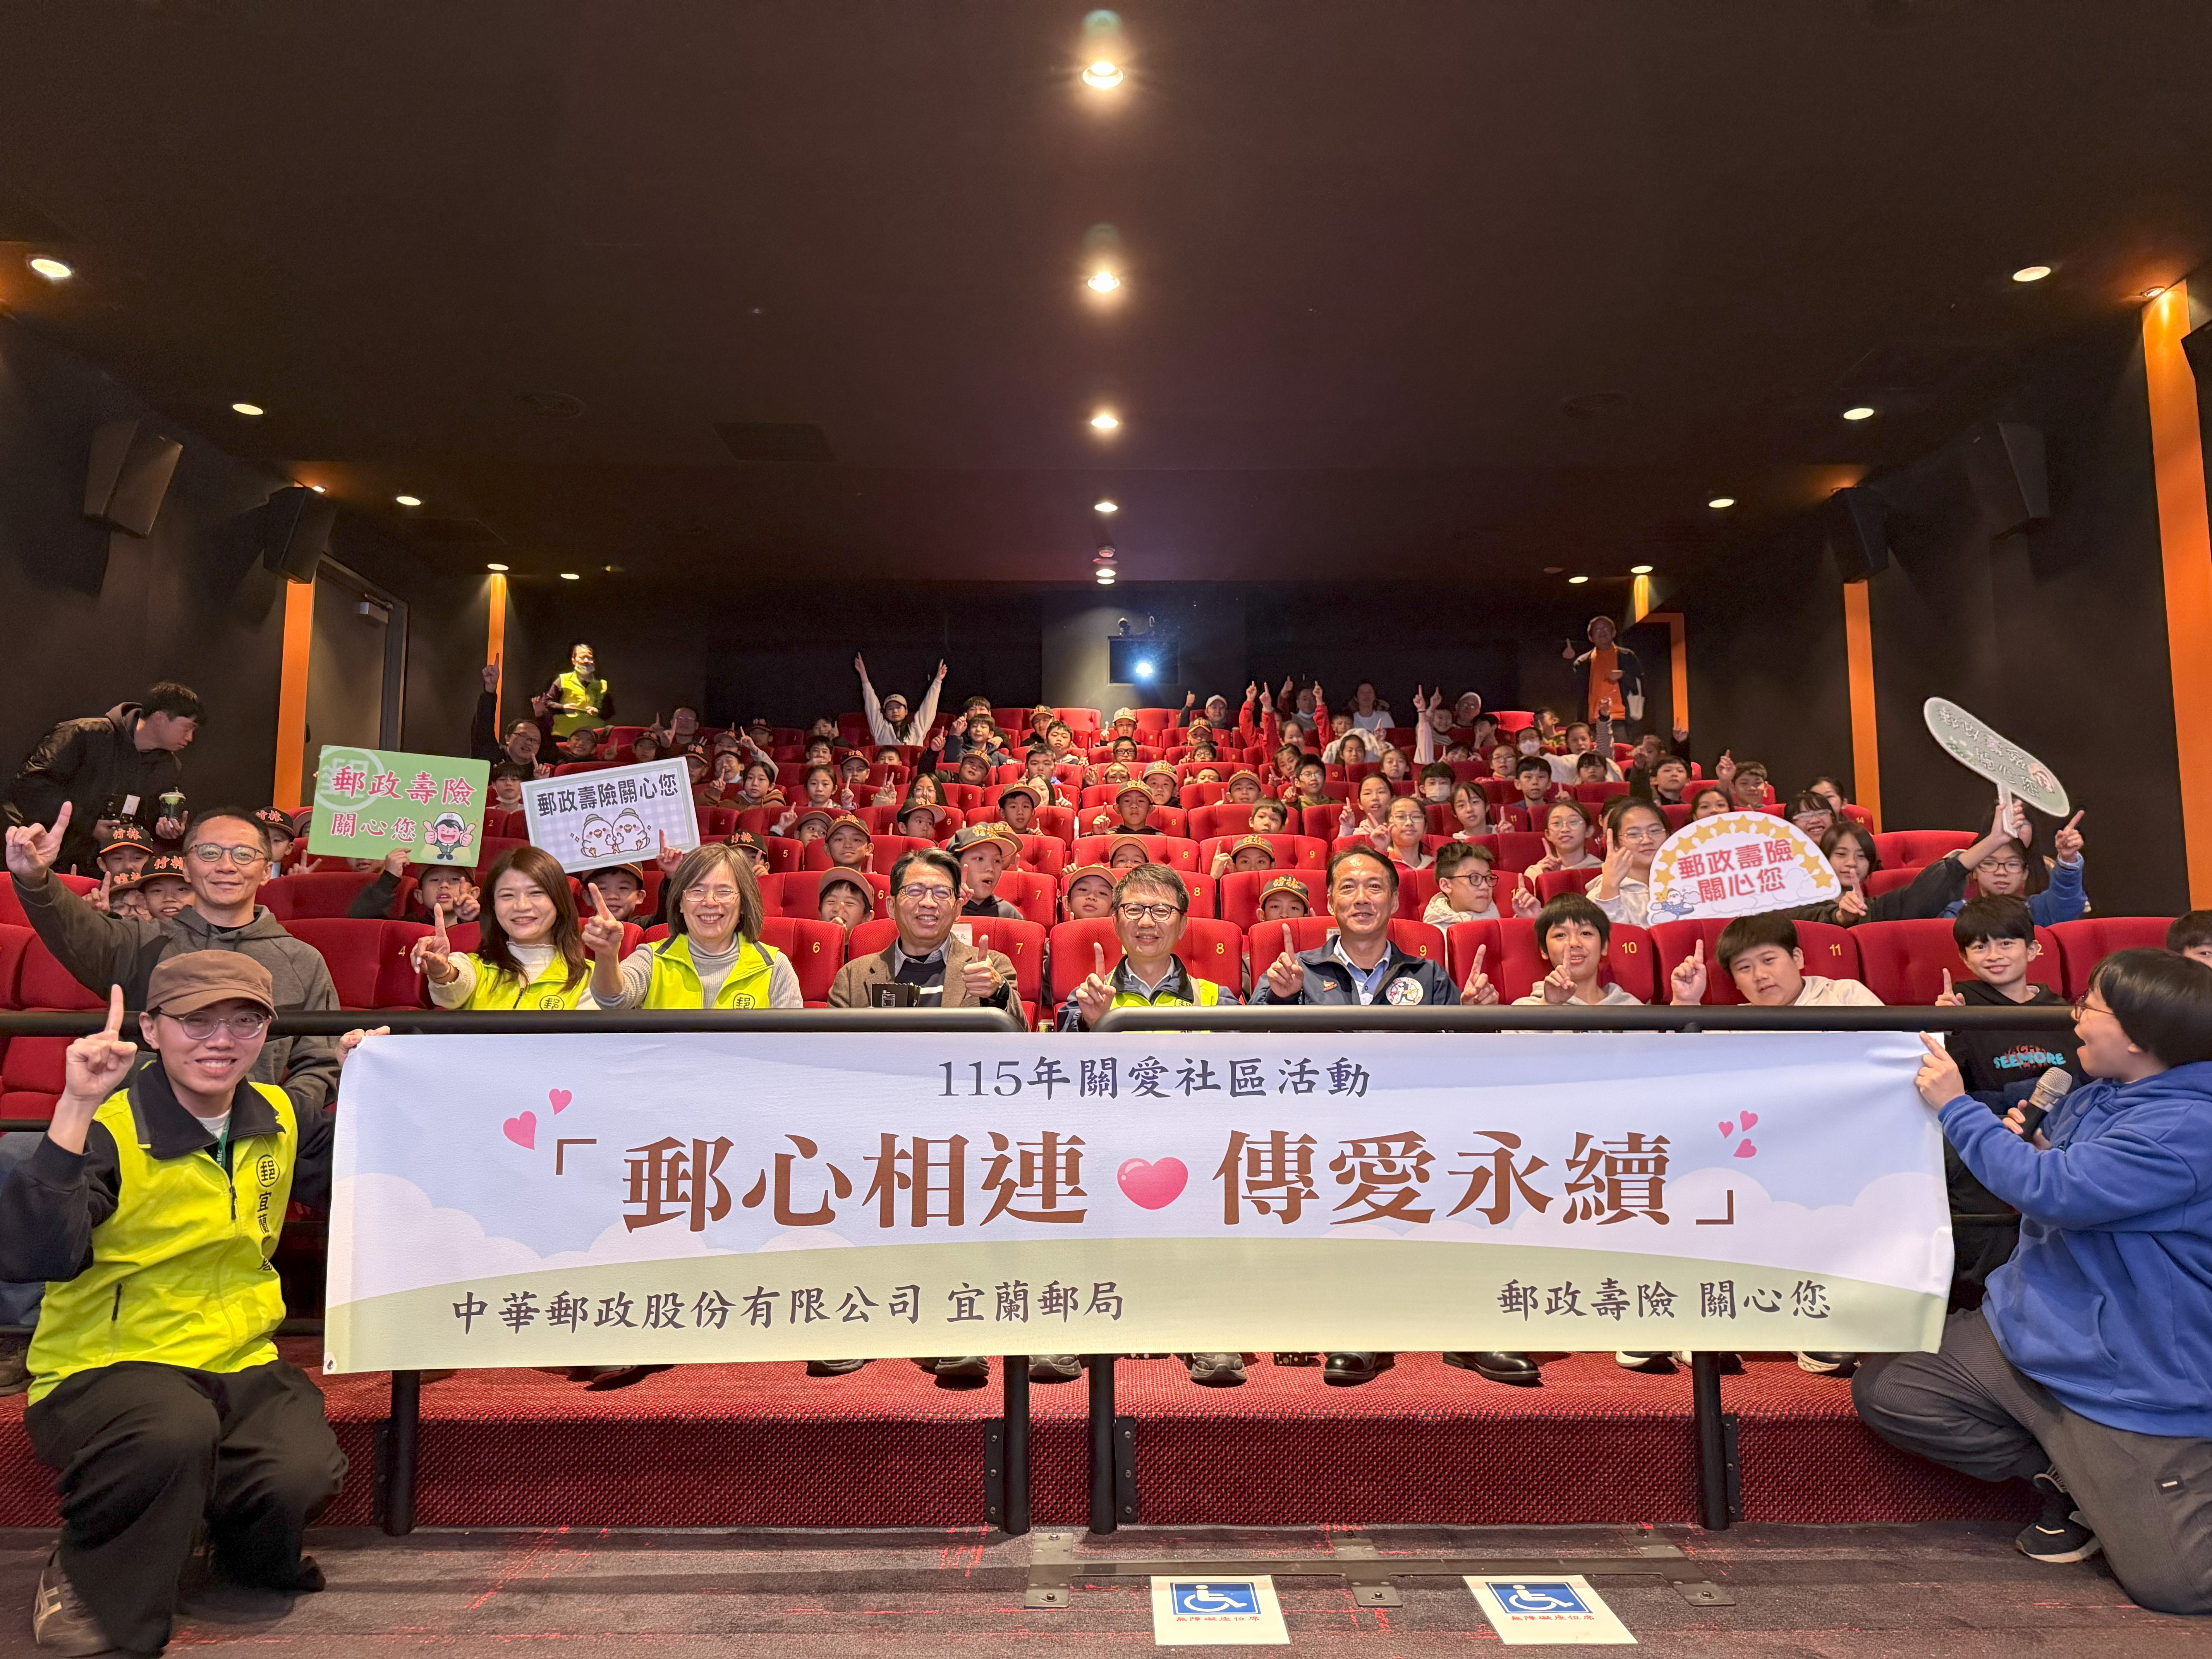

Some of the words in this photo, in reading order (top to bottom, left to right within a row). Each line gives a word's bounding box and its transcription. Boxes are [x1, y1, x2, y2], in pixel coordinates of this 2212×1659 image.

[332, 766, 476, 806] 郵政壽險
[537, 773, 678, 817] 郵政壽險關心您
[256, 810, 283, 822] 竹林
[331, 813, 416, 842] 關心您
[113, 828, 142, 840] 竹林
[782, 850, 788, 858] 5
[1047, 850, 1052, 858] 7
[1309, 850, 1314, 859] 9
[1677, 839, 1794, 880] 郵政壽險
[1273, 876, 1301, 889] 竹林
[1697, 867, 1786, 903] 關心您
[878, 890, 884, 899] 6
[1035, 890, 1041, 900] 7
[1194, 887, 1200, 896] 8
[398, 946, 406, 957] 4
[813, 942, 820, 953] 6
[1015, 943, 1023, 954] 7
[1216, 943, 1224, 954] 8
[1419, 945, 1427, 957] 9
[1622, 942, 1637, 953] 10
[1829, 944, 1841, 956] 11
[1993, 1051, 2066, 1069] SEEMORE
[939, 1056, 1369, 1100] 115年關愛社區活動
[260, 1160, 275, 1182] 郵
[1497, 1278, 1678, 1321] 郵政壽險
[1700, 1280, 1831, 1319] 關心您
[453, 1285, 921, 1334] 中華郵政股份有限公司
[947, 1280, 1123, 1322] 宜蘭郵局
